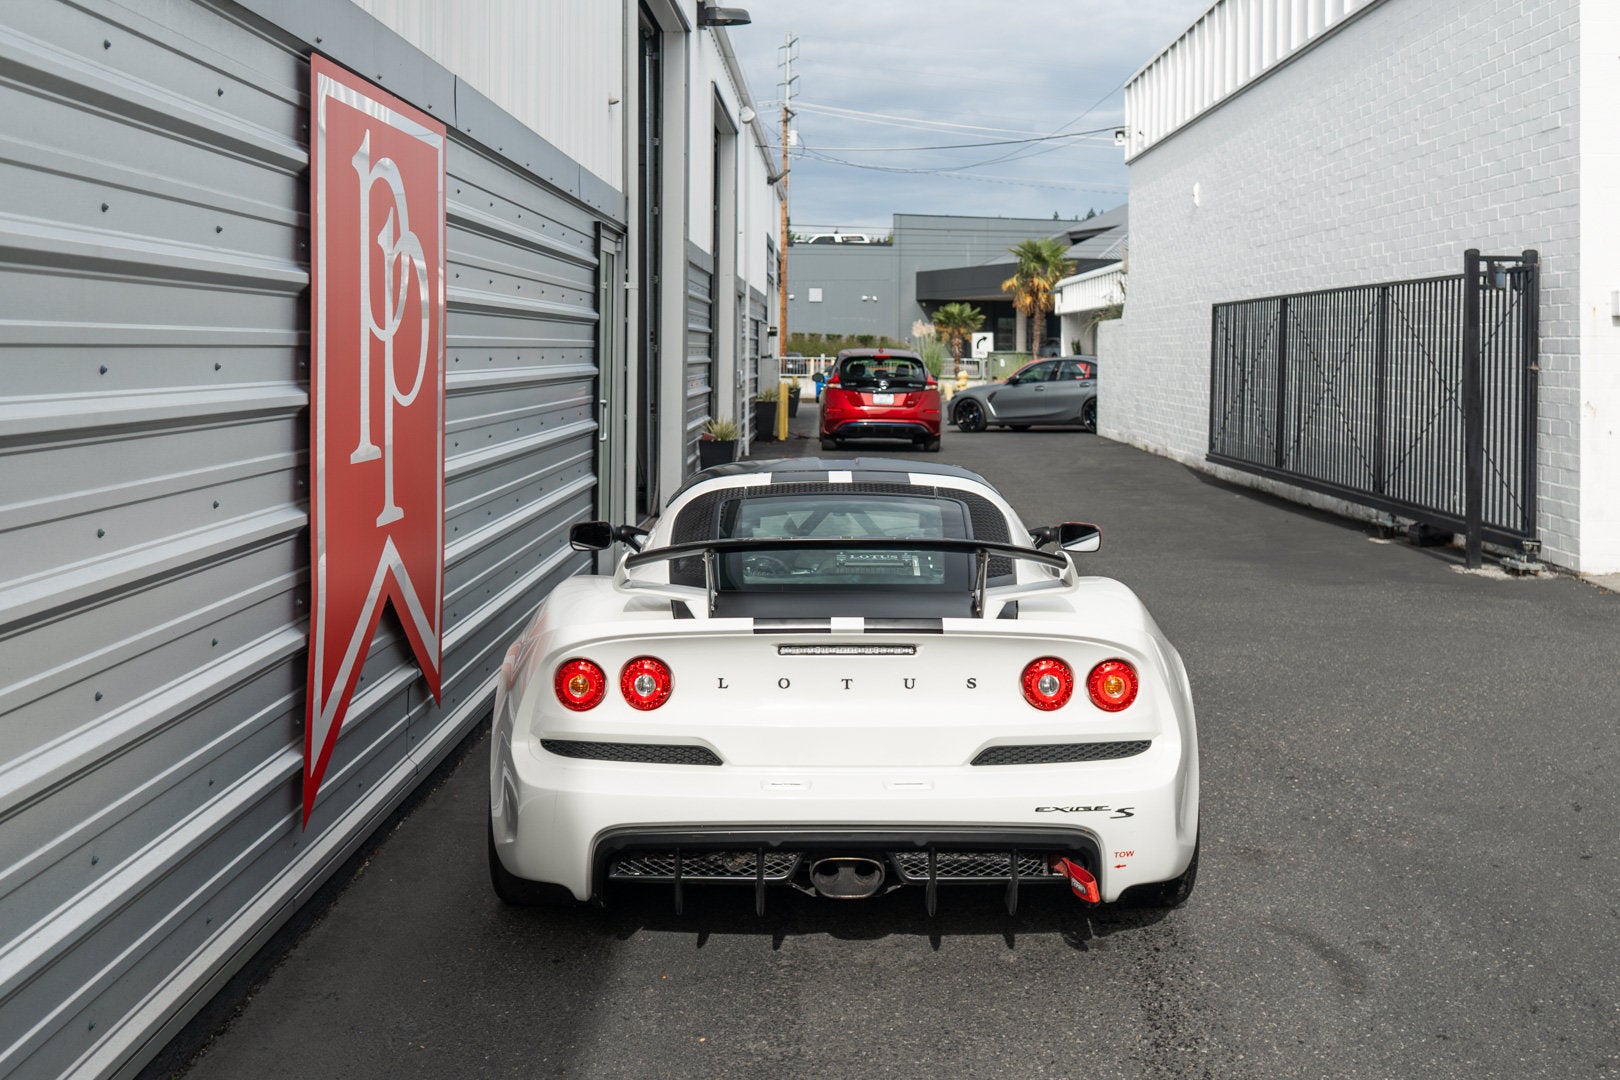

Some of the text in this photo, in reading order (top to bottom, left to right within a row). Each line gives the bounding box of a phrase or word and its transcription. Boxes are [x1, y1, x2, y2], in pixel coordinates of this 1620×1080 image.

[717, 677, 977, 690] LOTUS
[1035, 805, 1135, 819] EXIGE S
[1113, 850, 1135, 858] TOW
